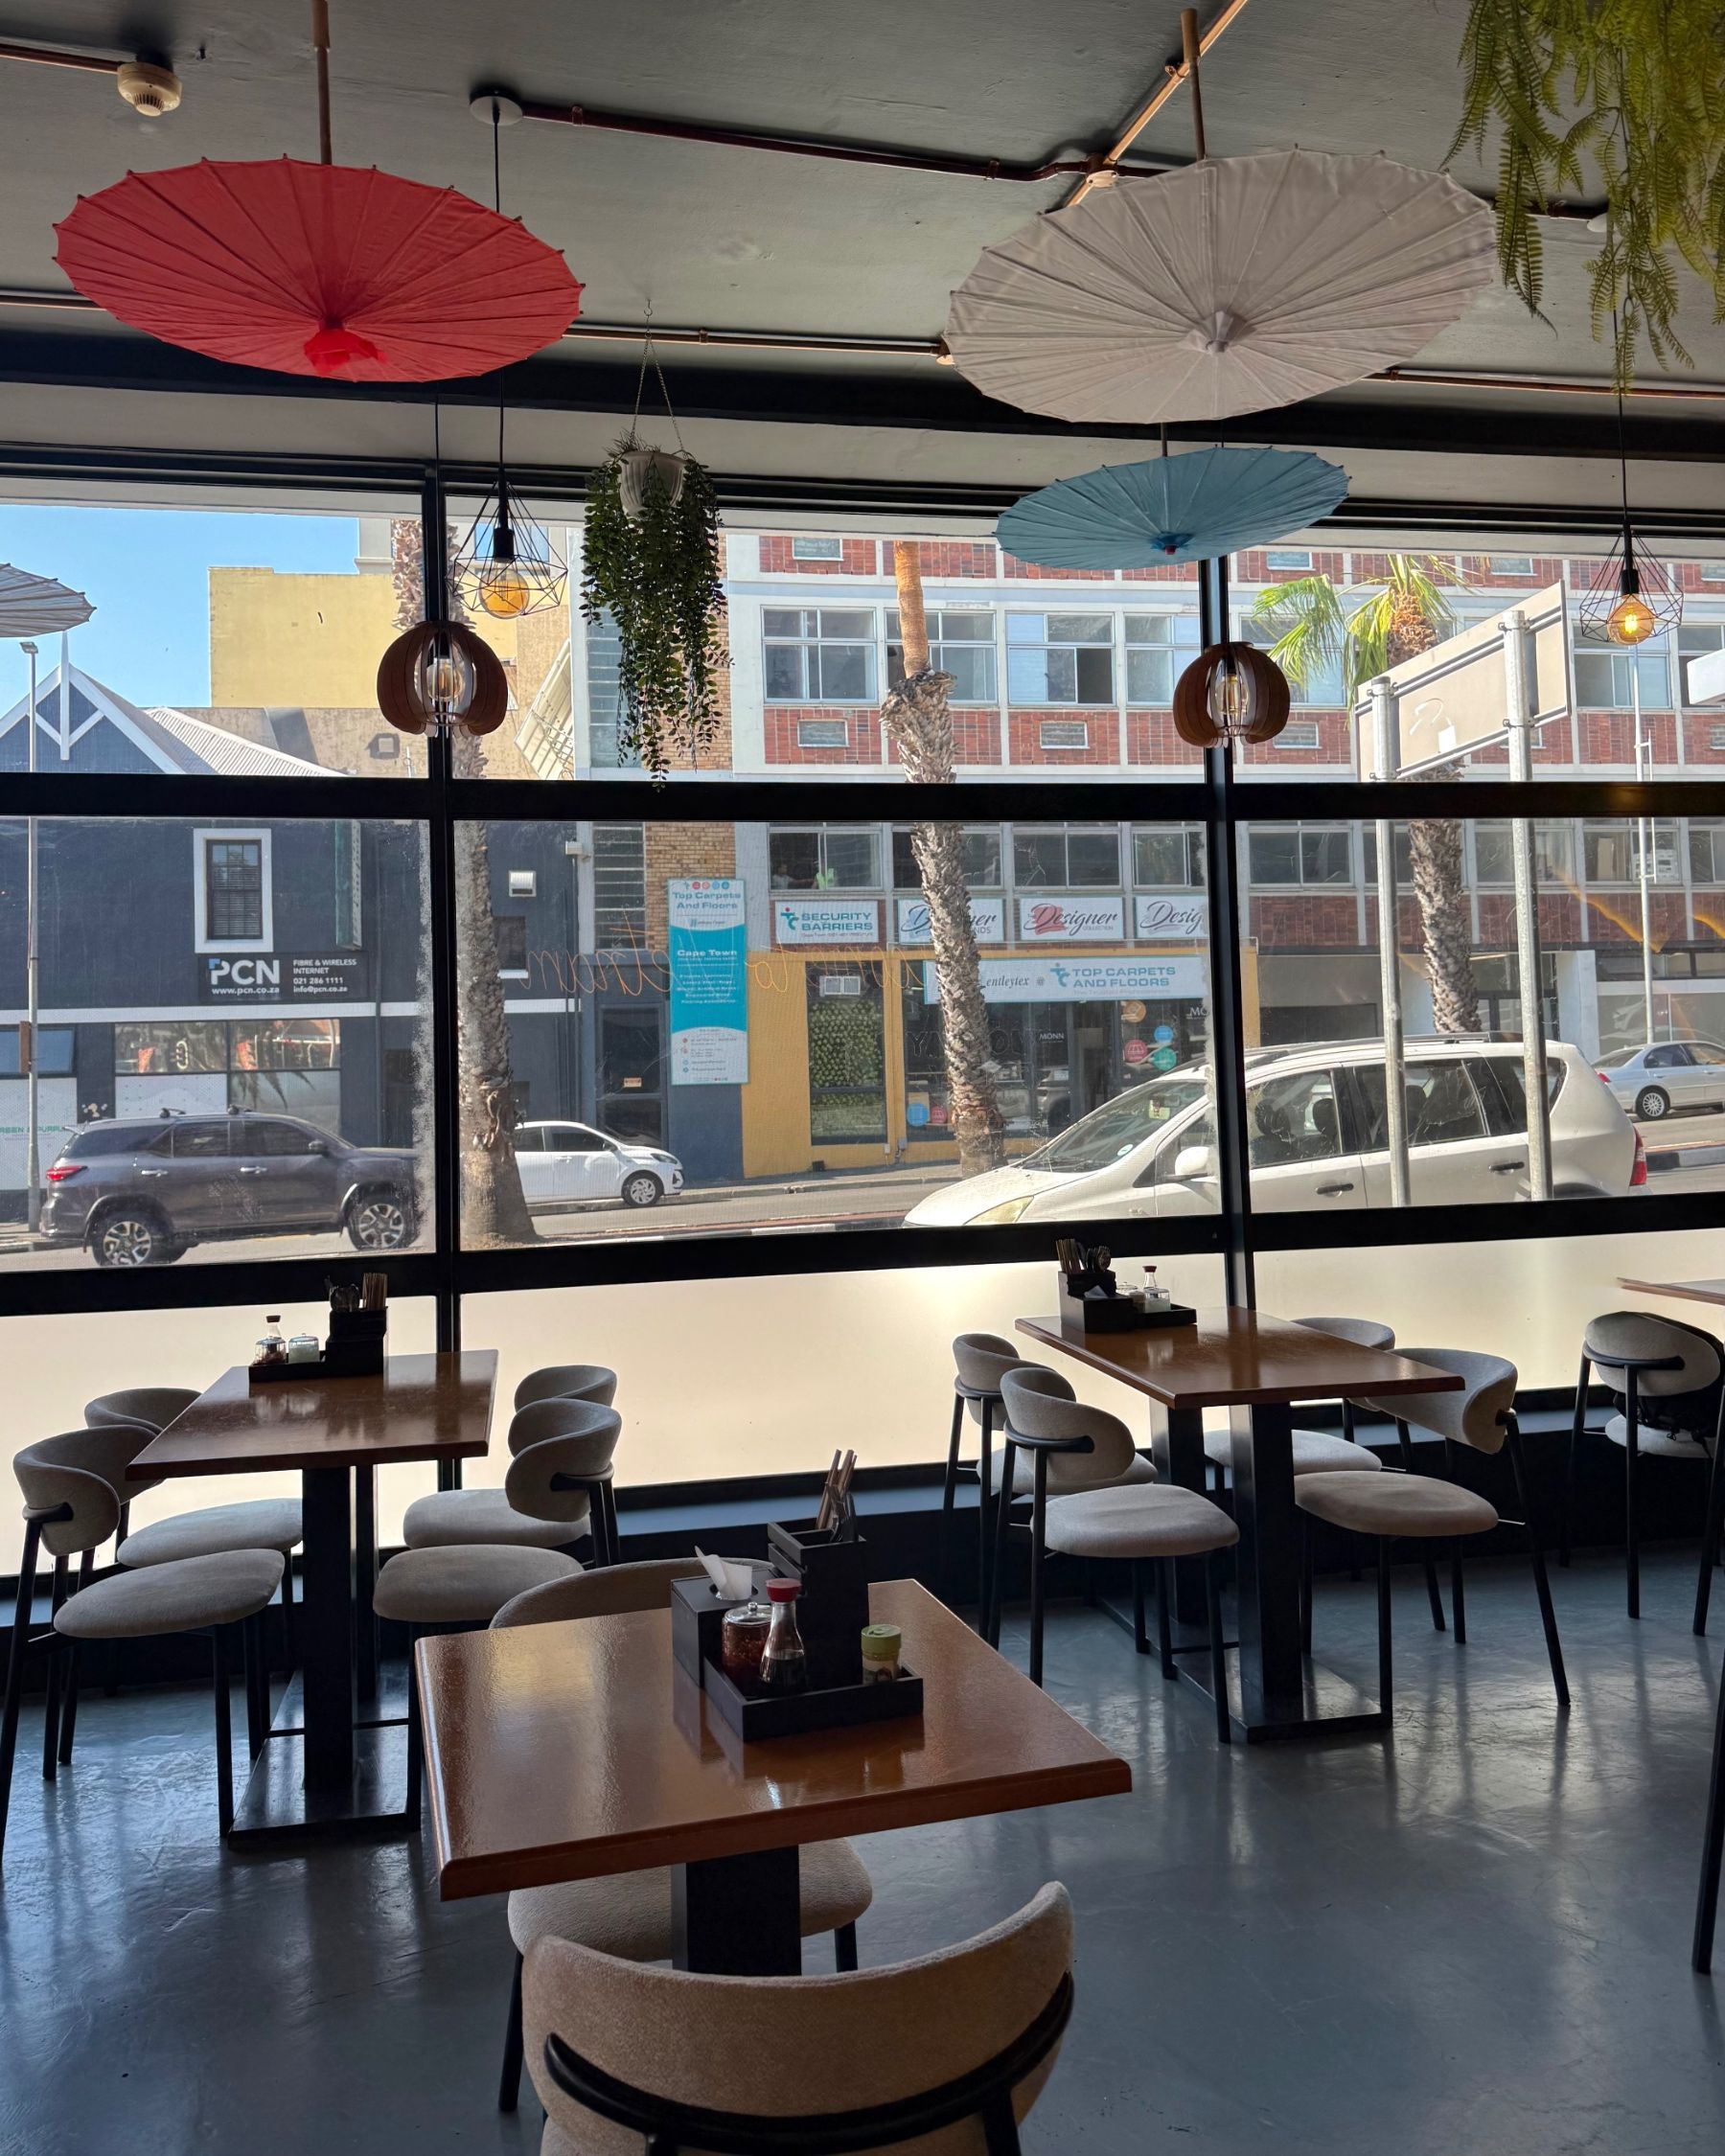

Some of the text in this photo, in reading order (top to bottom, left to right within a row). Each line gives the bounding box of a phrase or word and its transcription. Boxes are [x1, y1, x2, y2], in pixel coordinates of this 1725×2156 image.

[695, 891, 742, 900] Carpets
[801, 912, 872, 921] SECURITY
[1024, 903, 1117, 936] Designer
[801, 922, 873, 930] BARRIERS
[708, 949, 738, 957] Town
[209, 958, 280, 985] PCN
[1072, 967, 1176, 977] TOP CARPETS
[1073, 977, 1170, 988] AND FLOORS
[212, 987, 280, 996] www.pcn.co.za
[293, 986, 348, 995] info@pcn.co.za
